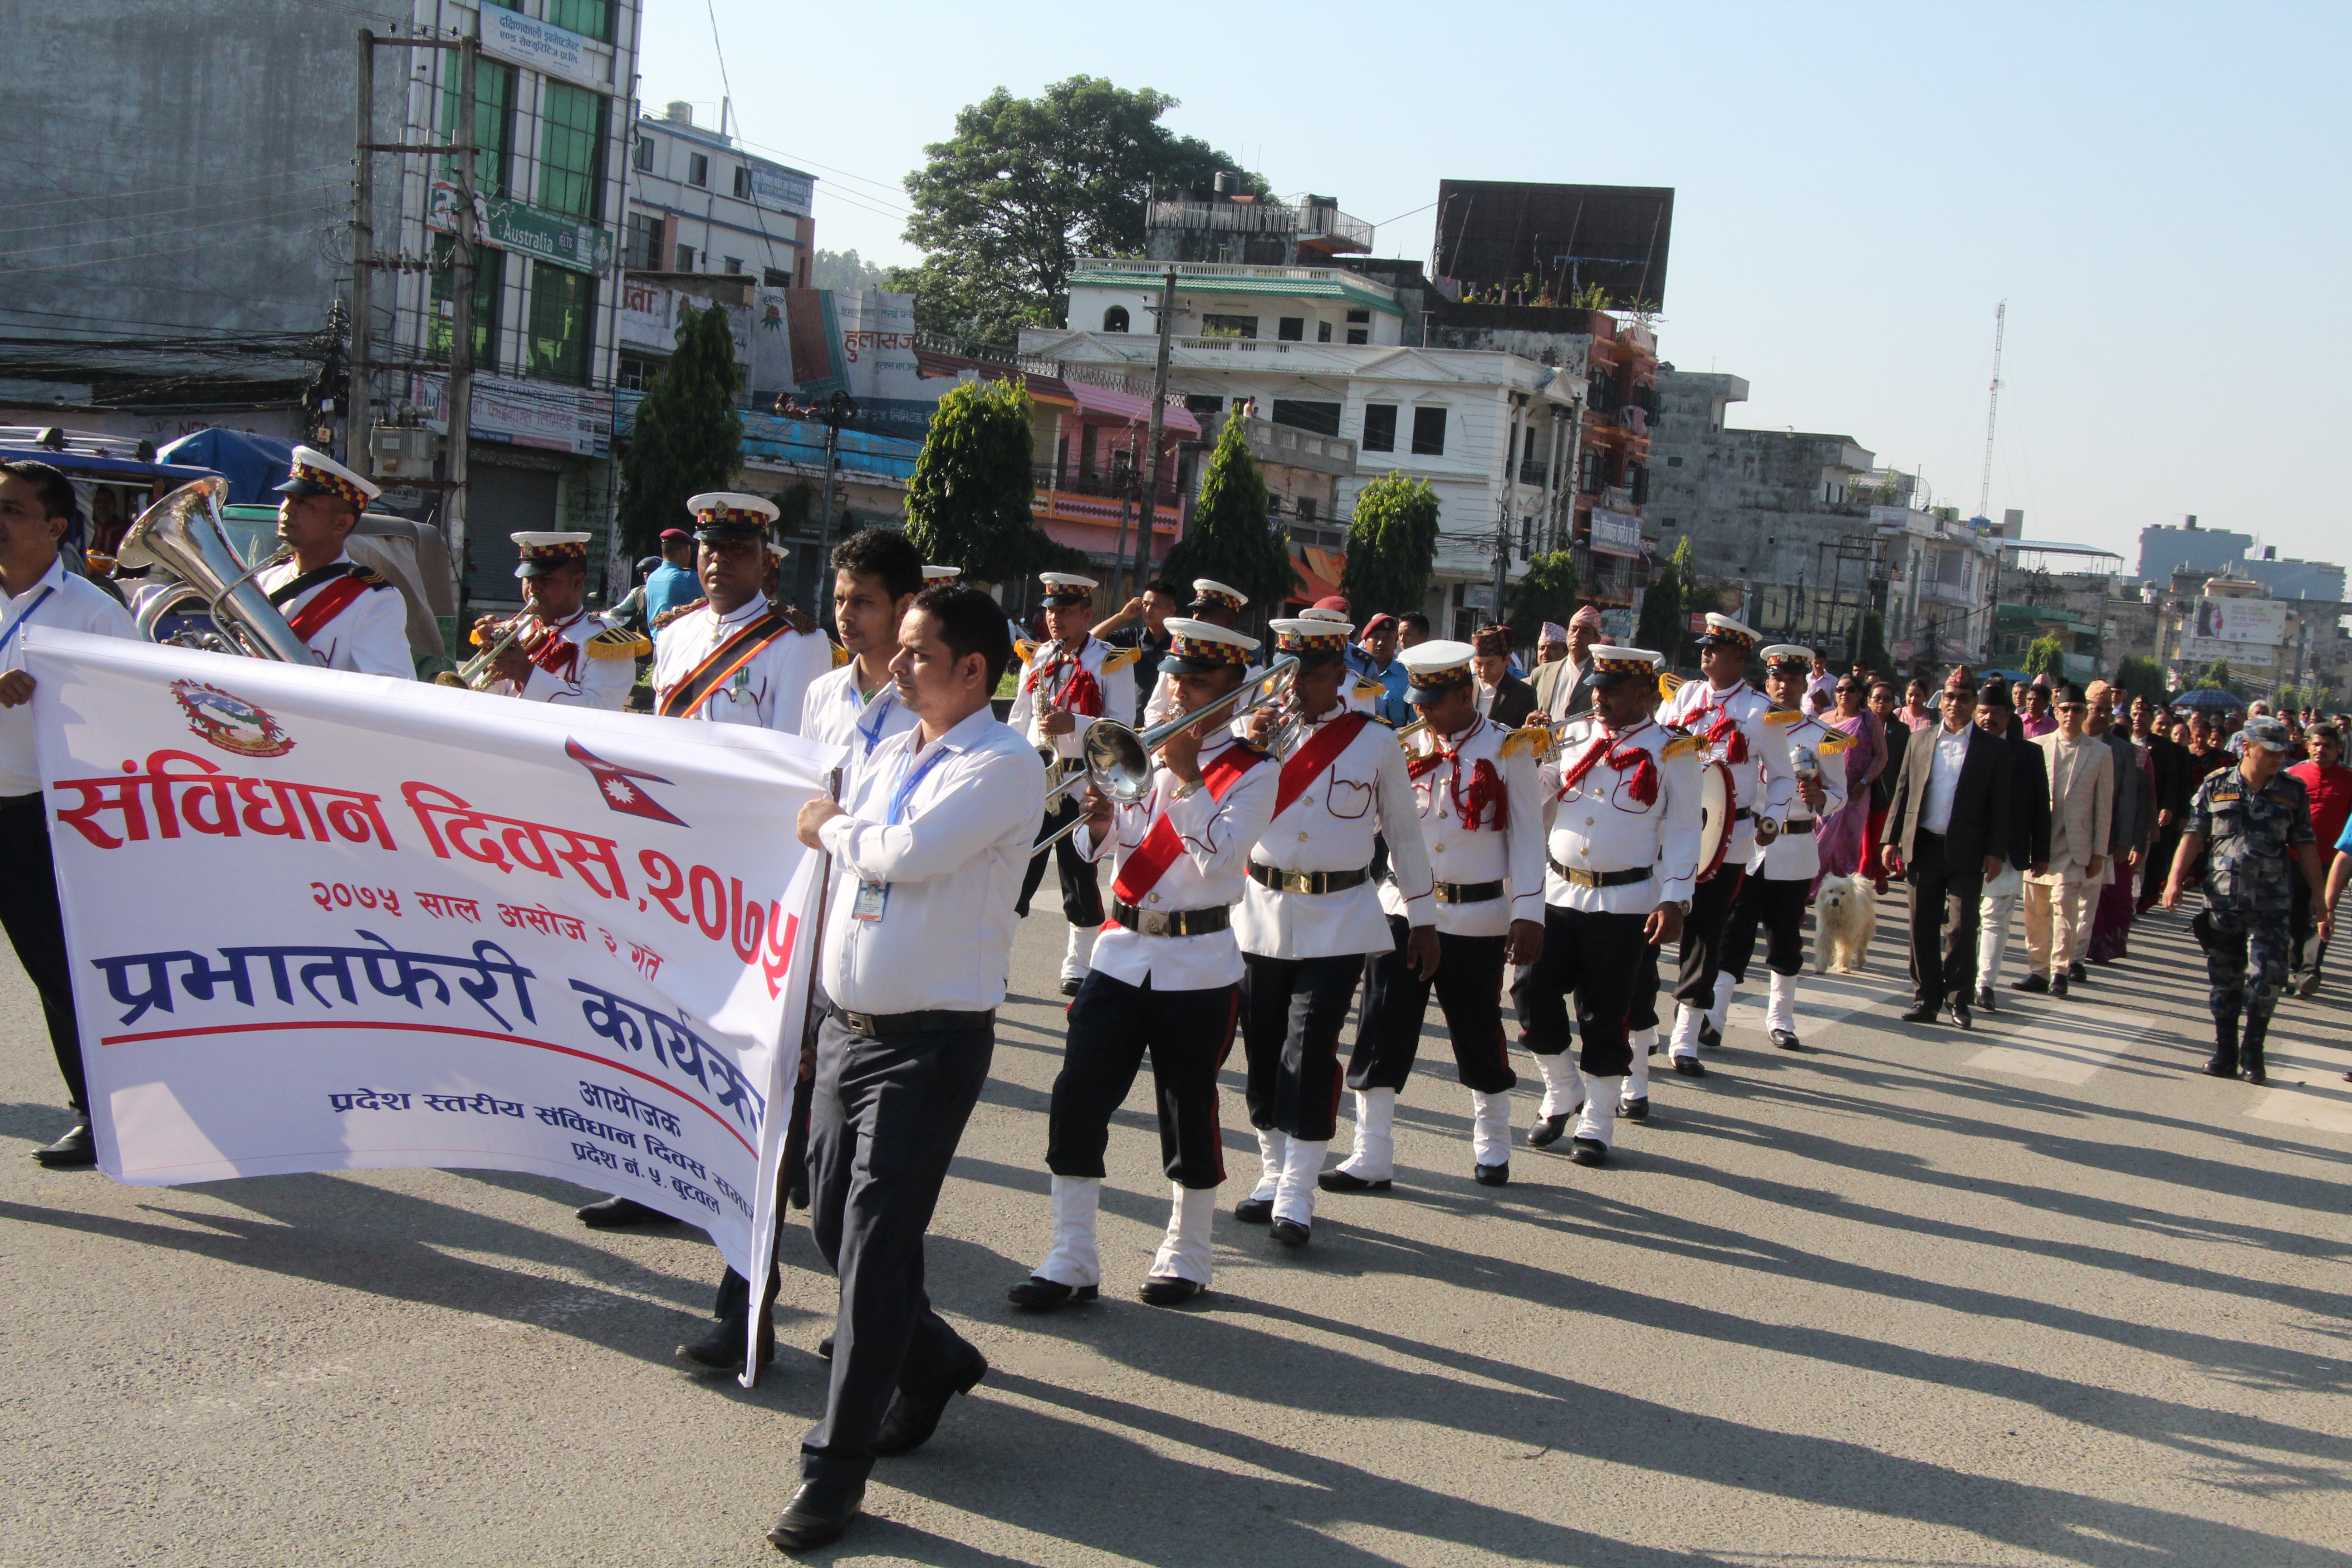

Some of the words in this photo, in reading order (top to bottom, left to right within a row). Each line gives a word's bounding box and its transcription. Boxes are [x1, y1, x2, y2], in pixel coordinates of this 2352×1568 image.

[500, 30, 516, 43] एण्ड
[503, 227, 553, 253] Australia
[559, 234, 573, 248] IELTS
[844, 330, 900, 363] हुलास
[509, 386, 543, 401] FINANCE
[54, 750, 398, 850] संविधान
[310, 882, 402, 917] २०७५
[414, 892, 481, 923] साल
[497, 902, 588, 943] असोज
[91, 929, 537, 1033] प्रभातफेरी
[328, 1088, 412, 1113] प्रदेश
[422, 1093, 524, 1119] स्तरीय
[533, 1106, 637, 1149] संविधान
[644, 1133, 706, 1181] दिवस
[579, 1081, 681, 1137] आयोजक
[570, 1142, 618, 1169] प्रदेश
[670, 1175, 721, 1216] बुटवल
